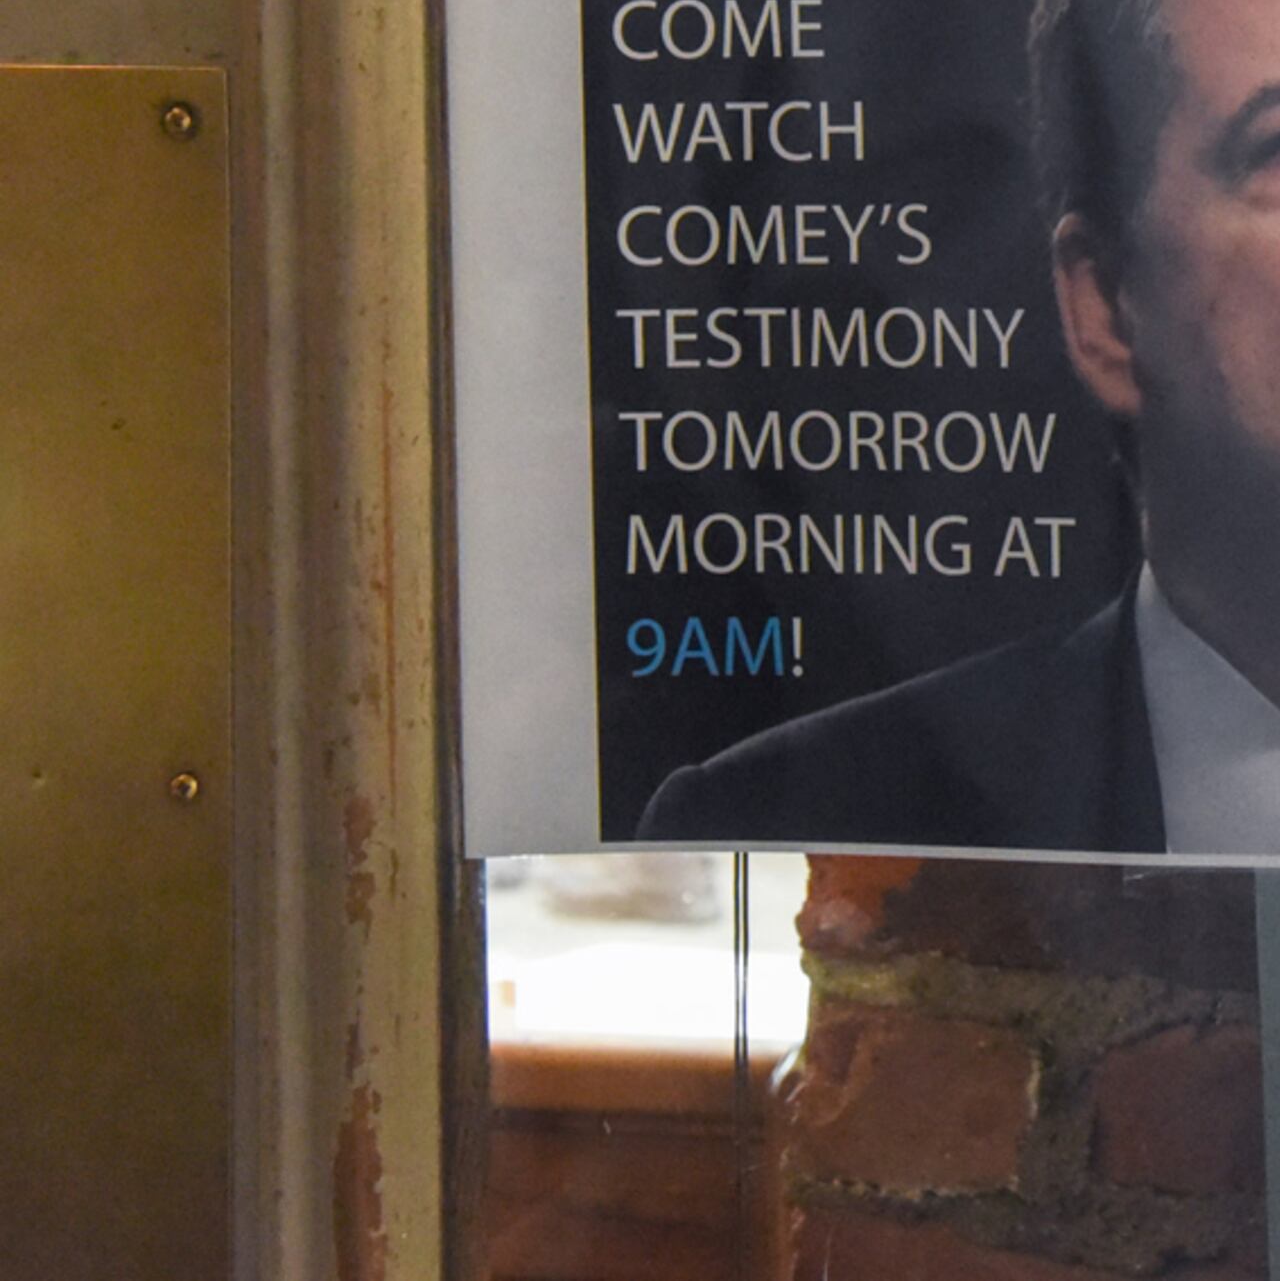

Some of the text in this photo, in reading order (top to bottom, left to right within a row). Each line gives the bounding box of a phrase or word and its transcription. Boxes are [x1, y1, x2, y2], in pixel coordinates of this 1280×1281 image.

[613, 100, 865, 163] WATCH
[616, 307, 1025, 370] TESTIMONY
[618, 410, 1056, 474] TOMORROW
[626, 512, 1076, 578] MORNING AT
[626, 616, 804, 677] 9AM!
